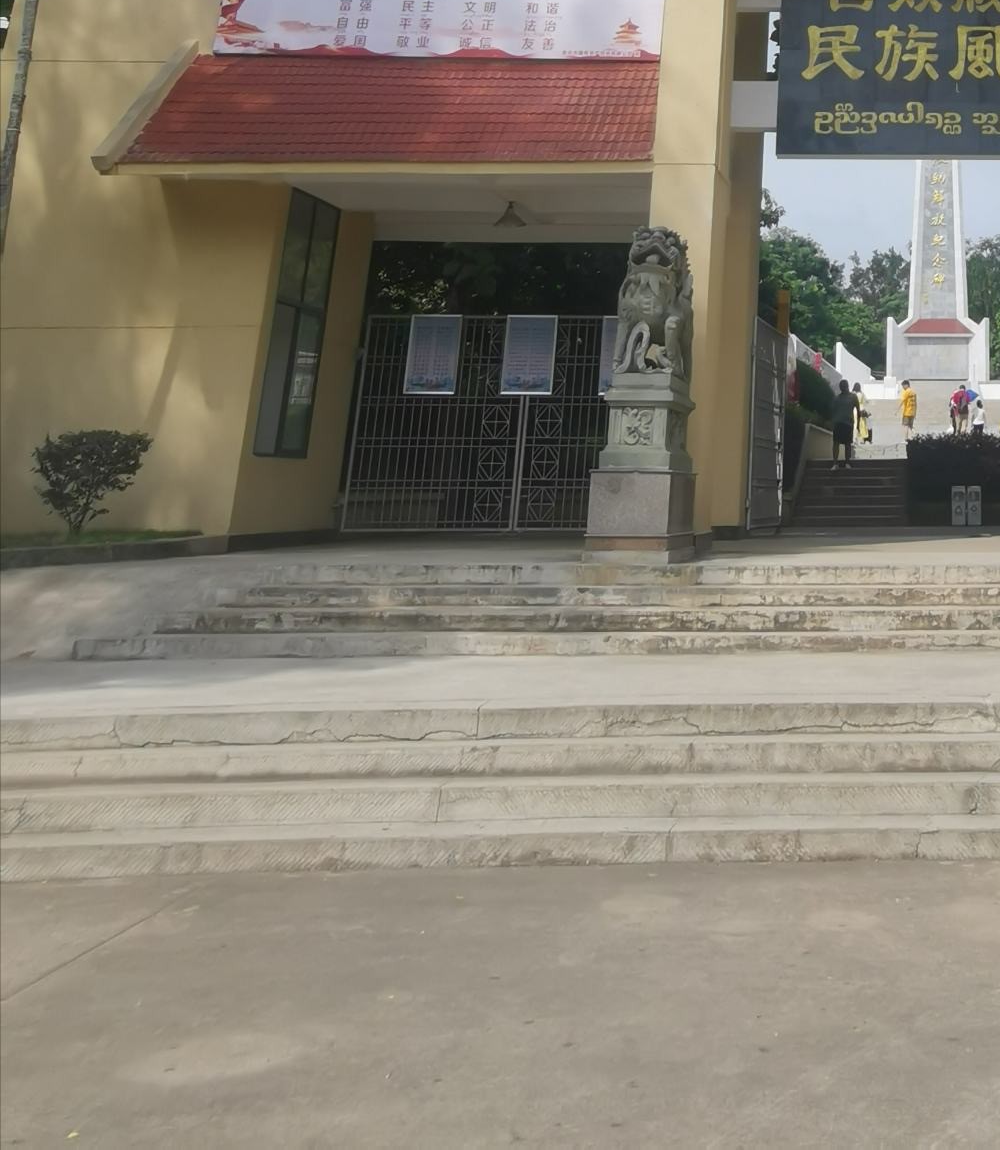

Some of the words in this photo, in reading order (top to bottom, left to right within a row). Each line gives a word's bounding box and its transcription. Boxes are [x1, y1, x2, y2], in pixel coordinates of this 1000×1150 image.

[339, 0, 373, 13] 富强
[401, 0, 435, 13] 民主
[463, 1, 497, 15] 文明
[525, 2, 560, 15] 和谐
[336, 17, 369, 30] 自由
[399, 17, 433, 31] 平等
[461, 19, 495, 32] 公正
[523, 19, 557, 32] 法治
[333, 35, 367, 48] 爱国
[396, 35, 430, 49] 敬业
[458, 37, 492, 50] 诚信
[521, 37, 555, 51] 友善
